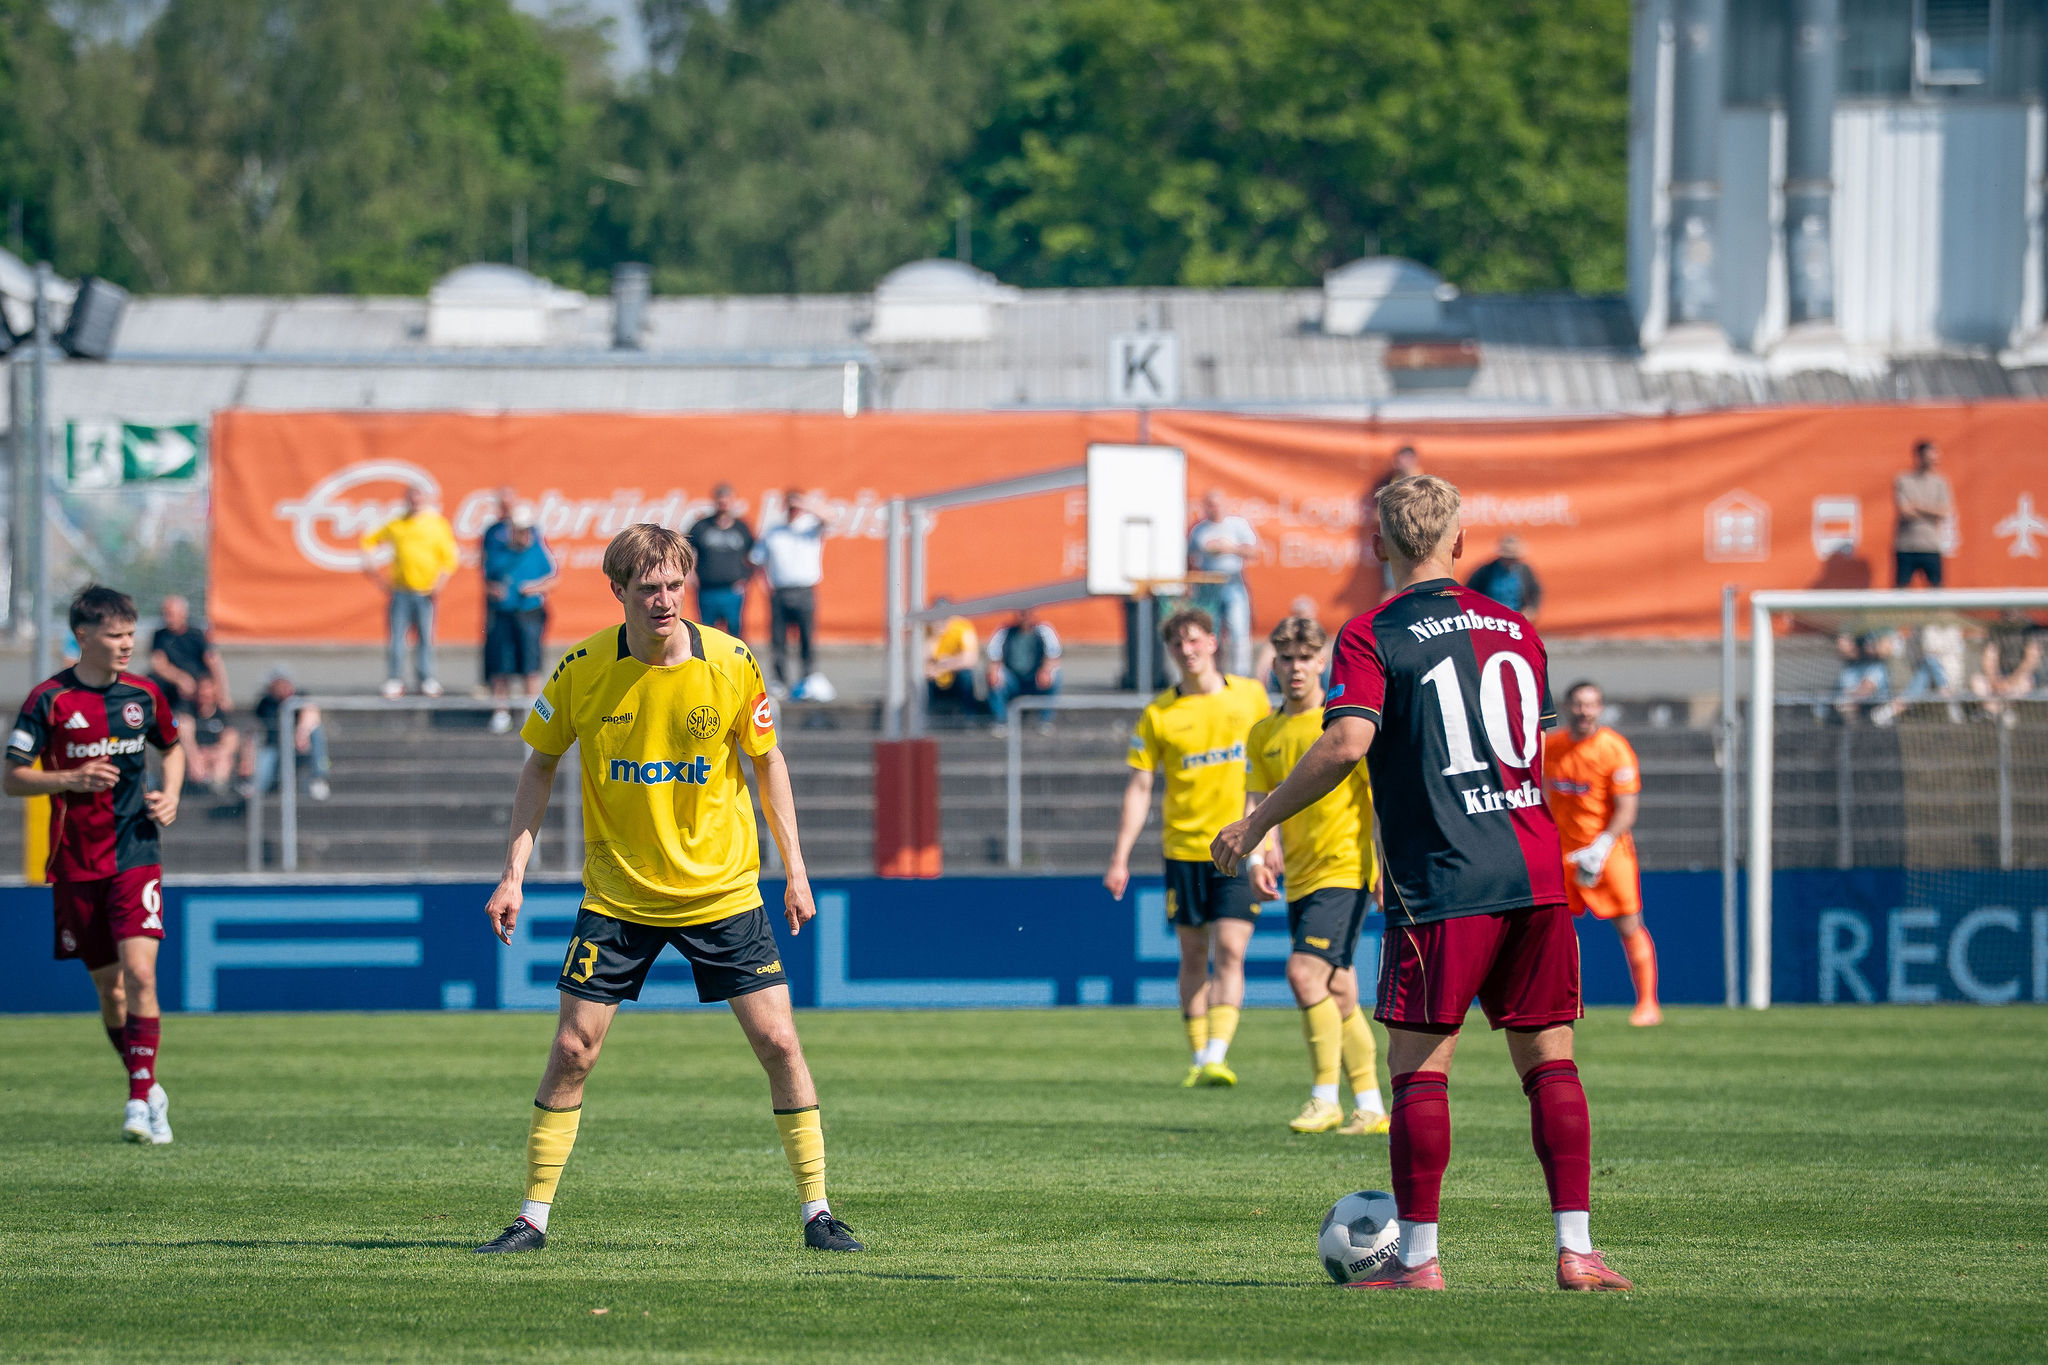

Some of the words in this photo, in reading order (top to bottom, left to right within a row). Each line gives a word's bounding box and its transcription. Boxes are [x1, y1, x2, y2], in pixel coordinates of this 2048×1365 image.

[1123, 343, 1162, 397] K
[454, 488, 748, 540] Gbrüde
[1407, 608, 1523, 643] Nürnberg
[601, 712, 633, 724] capelli
[1420, 650, 1540, 776] 10
[609, 755, 712, 785] maxit
[1461, 780, 1542, 815] Kirsch
[141, 879, 161, 914] 6
[562, 935, 599, 983] 13
